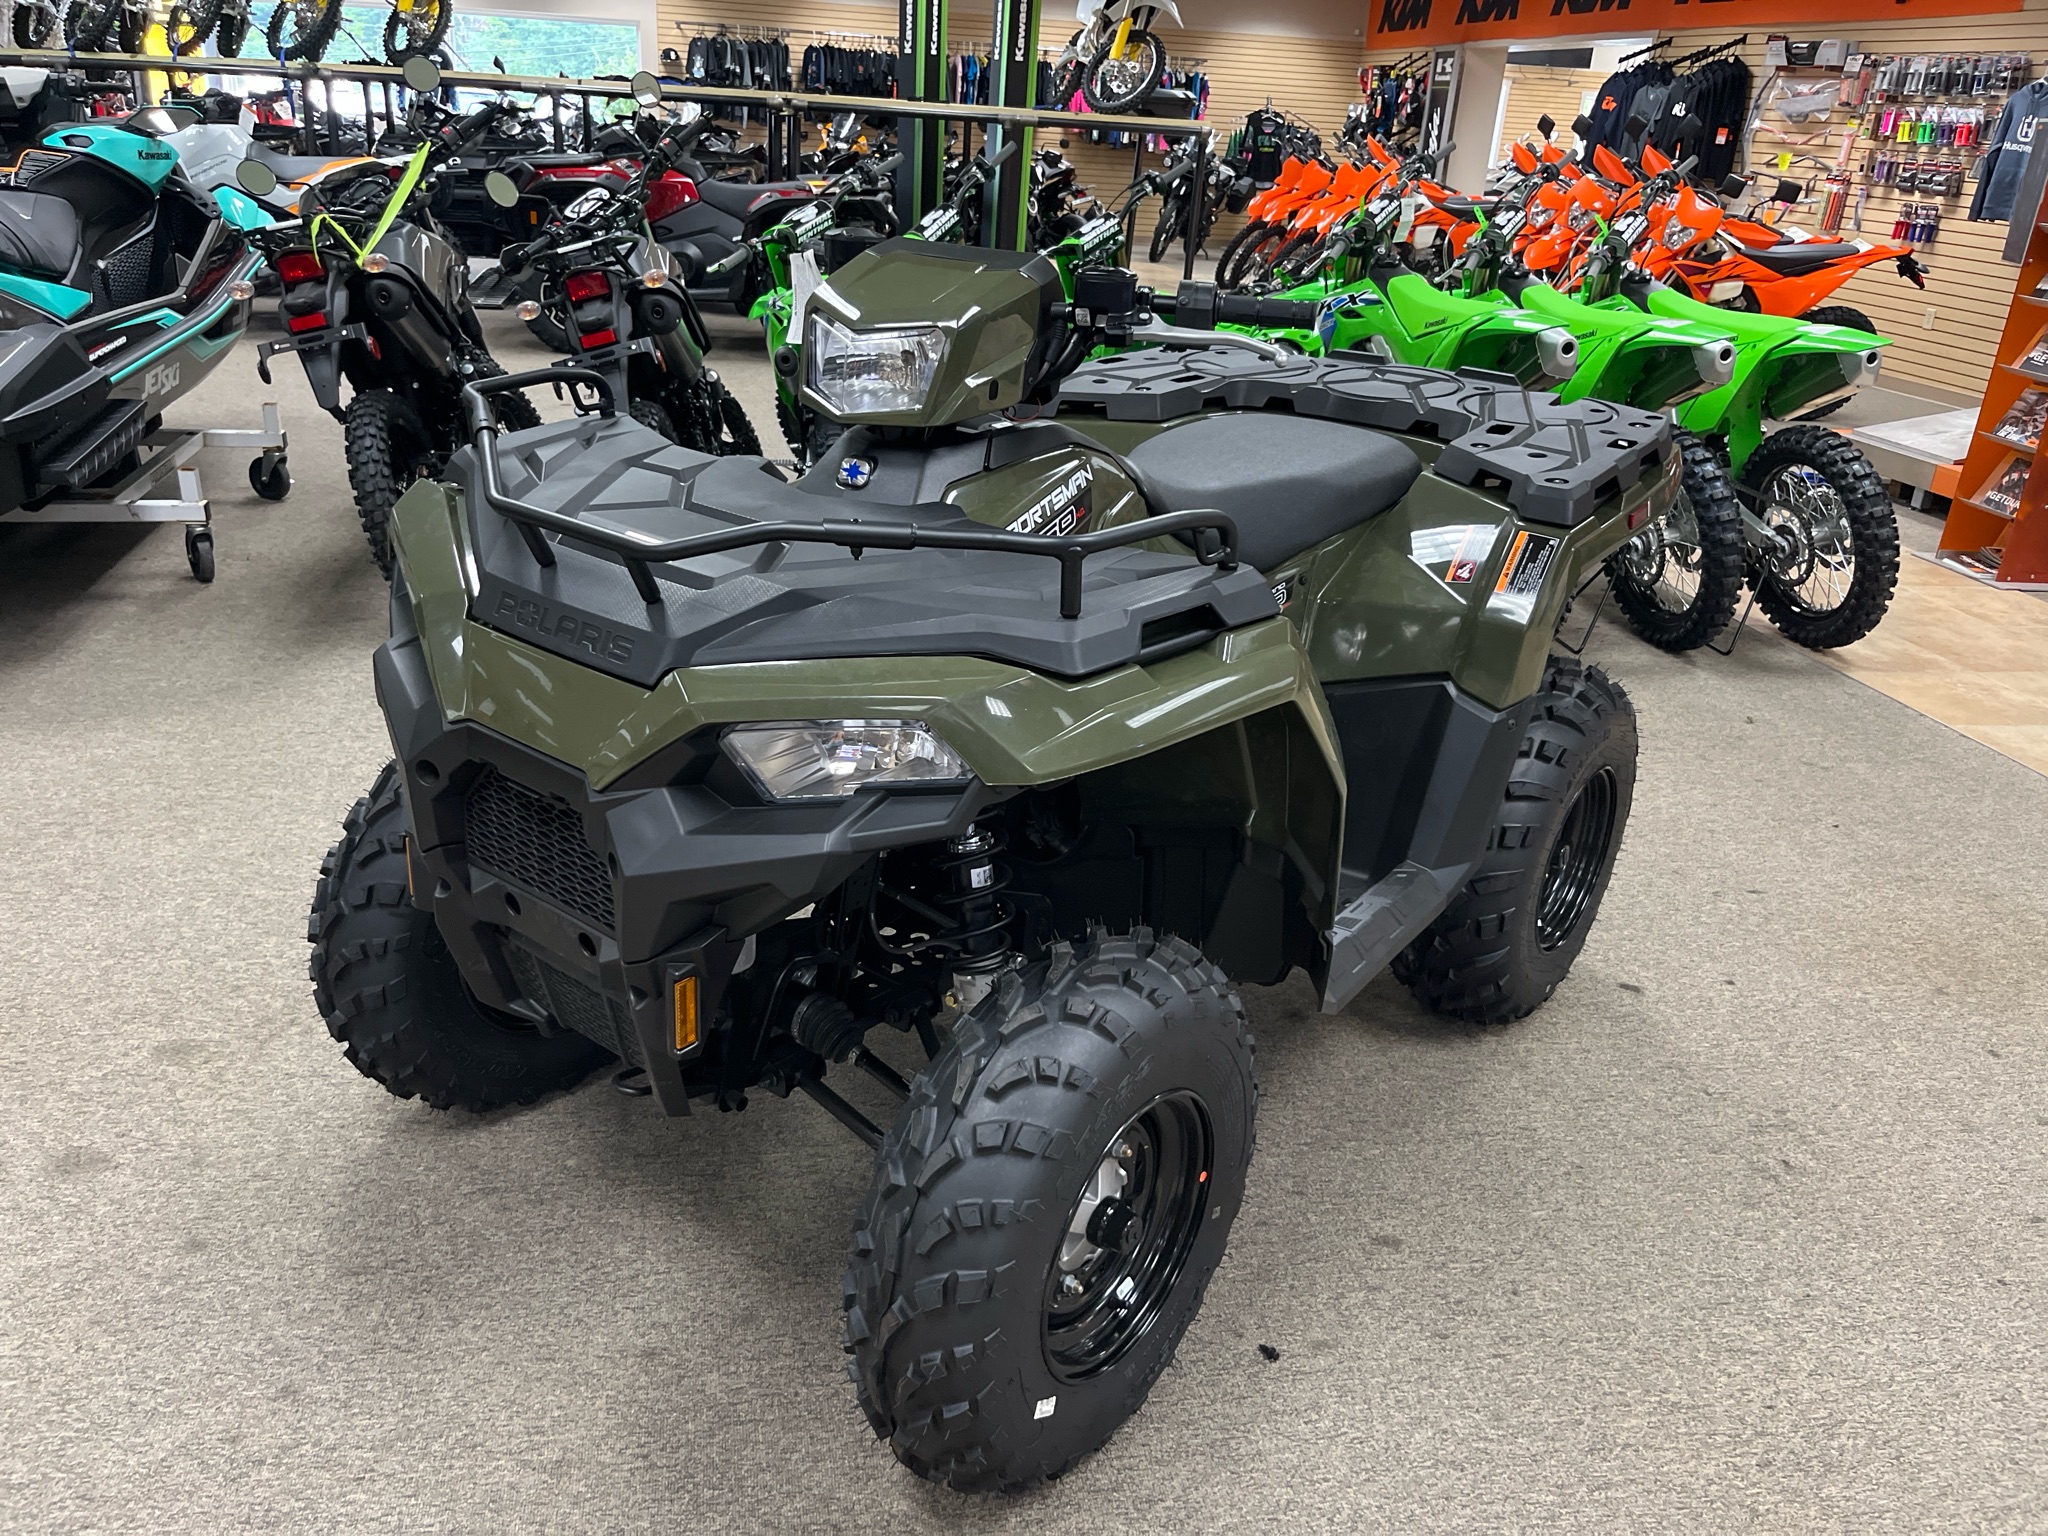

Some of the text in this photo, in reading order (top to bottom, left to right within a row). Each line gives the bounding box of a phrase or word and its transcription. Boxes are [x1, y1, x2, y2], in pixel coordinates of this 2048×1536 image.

[993, 0, 1003, 60] Kawas
[1014, 0, 1028, 62] Kawas
[138, 149, 173, 160] Kawasaki
[1083, 223, 1120, 252] RENTHAL
[1005, 463, 1094, 534] PORTSMAN
[493, 591, 636, 665] POLARIS
